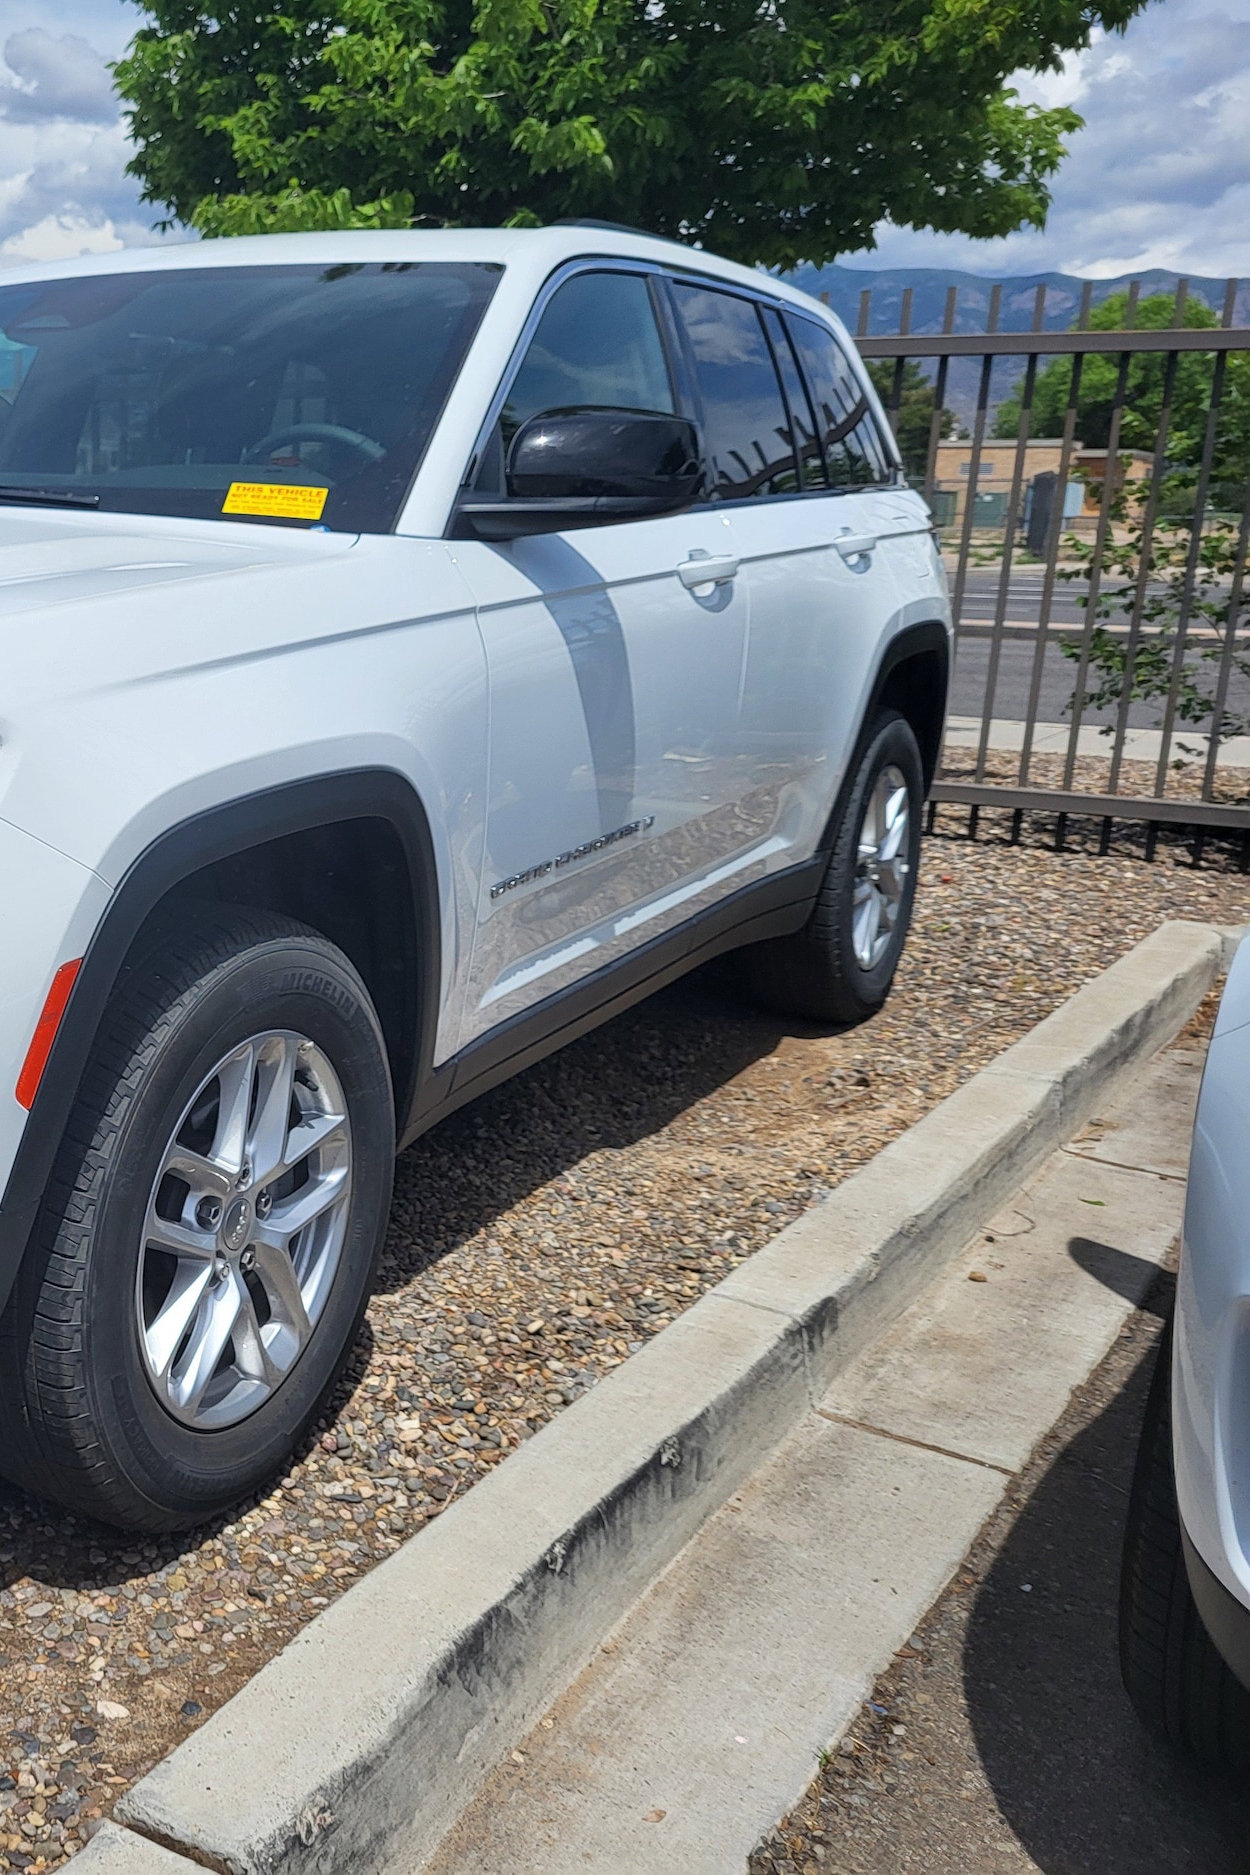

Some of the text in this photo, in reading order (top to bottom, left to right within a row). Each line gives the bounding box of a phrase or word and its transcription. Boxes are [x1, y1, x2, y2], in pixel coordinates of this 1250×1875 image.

[235, 485, 325, 499] THIS VEHICLE
[280, 972, 355, 1016] MICHELIN
